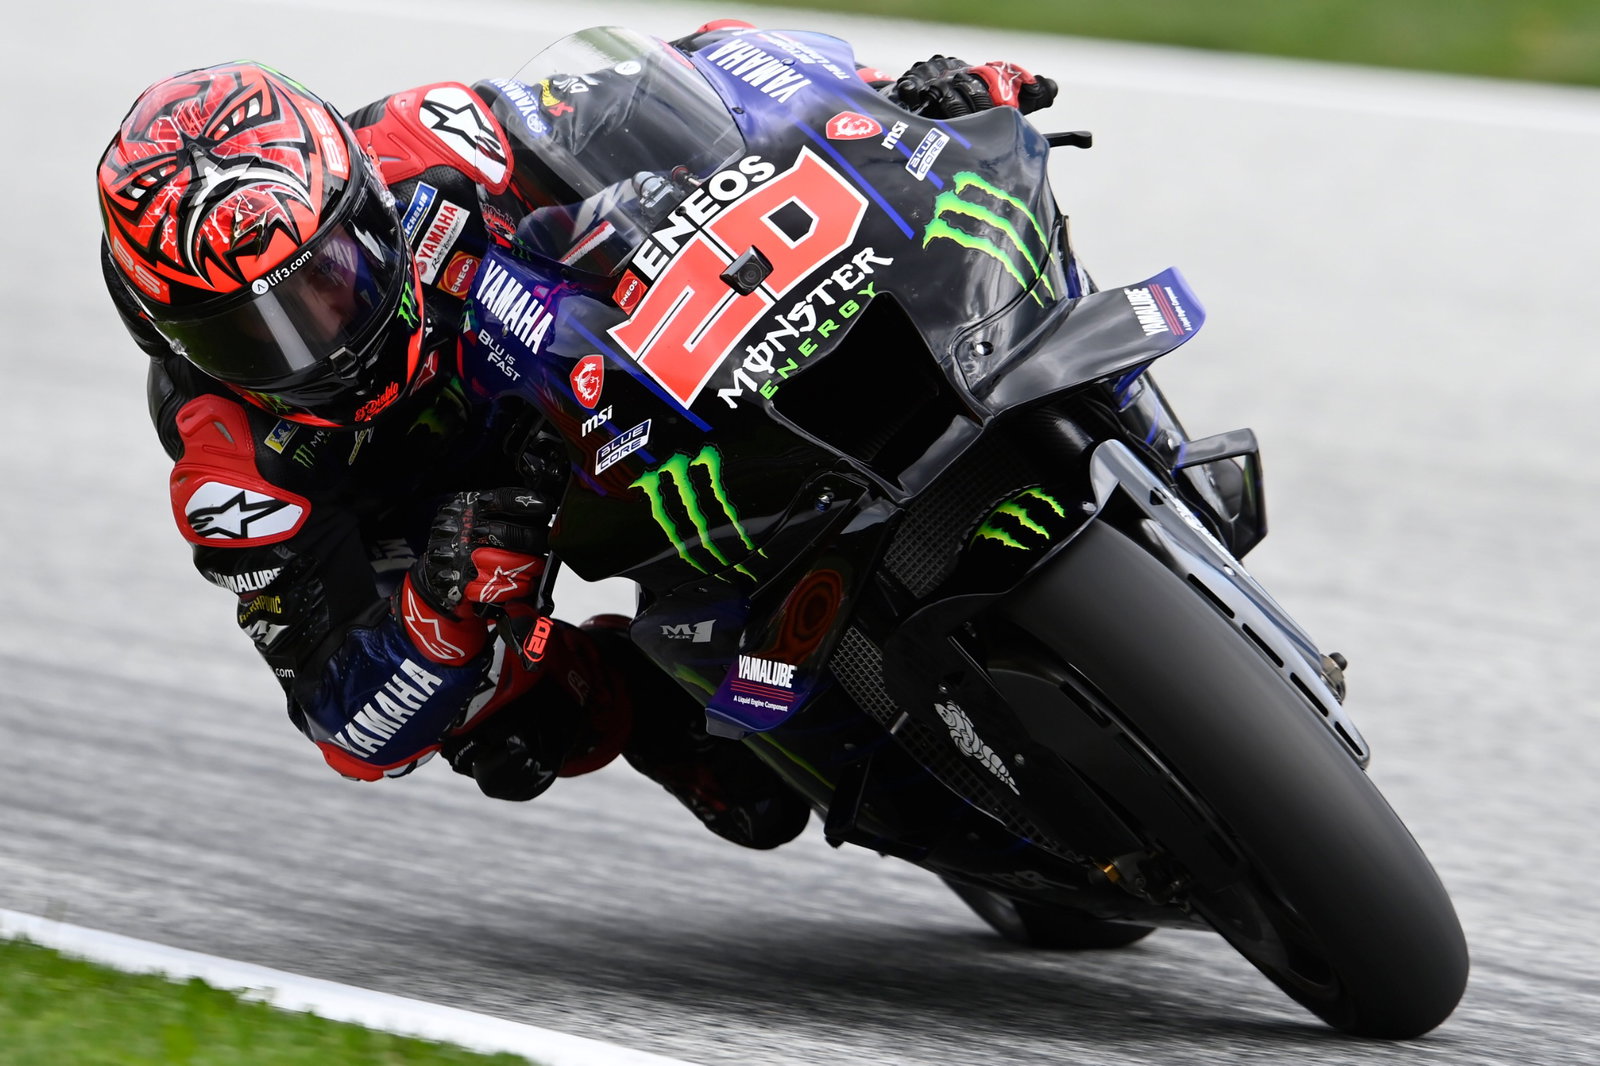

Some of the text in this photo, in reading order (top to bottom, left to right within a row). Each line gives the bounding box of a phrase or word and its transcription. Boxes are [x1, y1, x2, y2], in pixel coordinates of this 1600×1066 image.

[706, 38, 812, 104] YAMAHA
[881, 120, 909, 150] msi
[910, 132, 938, 168] BLUE
[919, 139, 945, 174] CORE
[404, 191, 428, 237] ICHELIN
[418, 204, 459, 259] YAMAHA
[633, 155, 775, 280] ENEOS
[266, 250, 313, 287] lif3.com
[450, 258, 474, 293] ENEOS
[476, 259, 554, 355] YAMAHA
[618, 278, 640, 306] ENEOS
[1124, 287, 1169, 336] YAMALUBE
[478, 328, 516, 366] BLU IS
[760, 281, 878, 400] ENERGY
[487, 352, 521, 381] FAST
[365, 381, 399, 413] Diablo
[582, 404, 613, 437] msi
[600, 438, 642, 470] CORE
[601, 425, 644, 458] BLUE
[738, 654, 795, 689] YAMALUBE
[327, 658, 443, 759] YAMAHA
[738, 696, 751, 705] Liquid
[751, 697, 765, 708] Engine
[764, 701, 789, 712] Component
